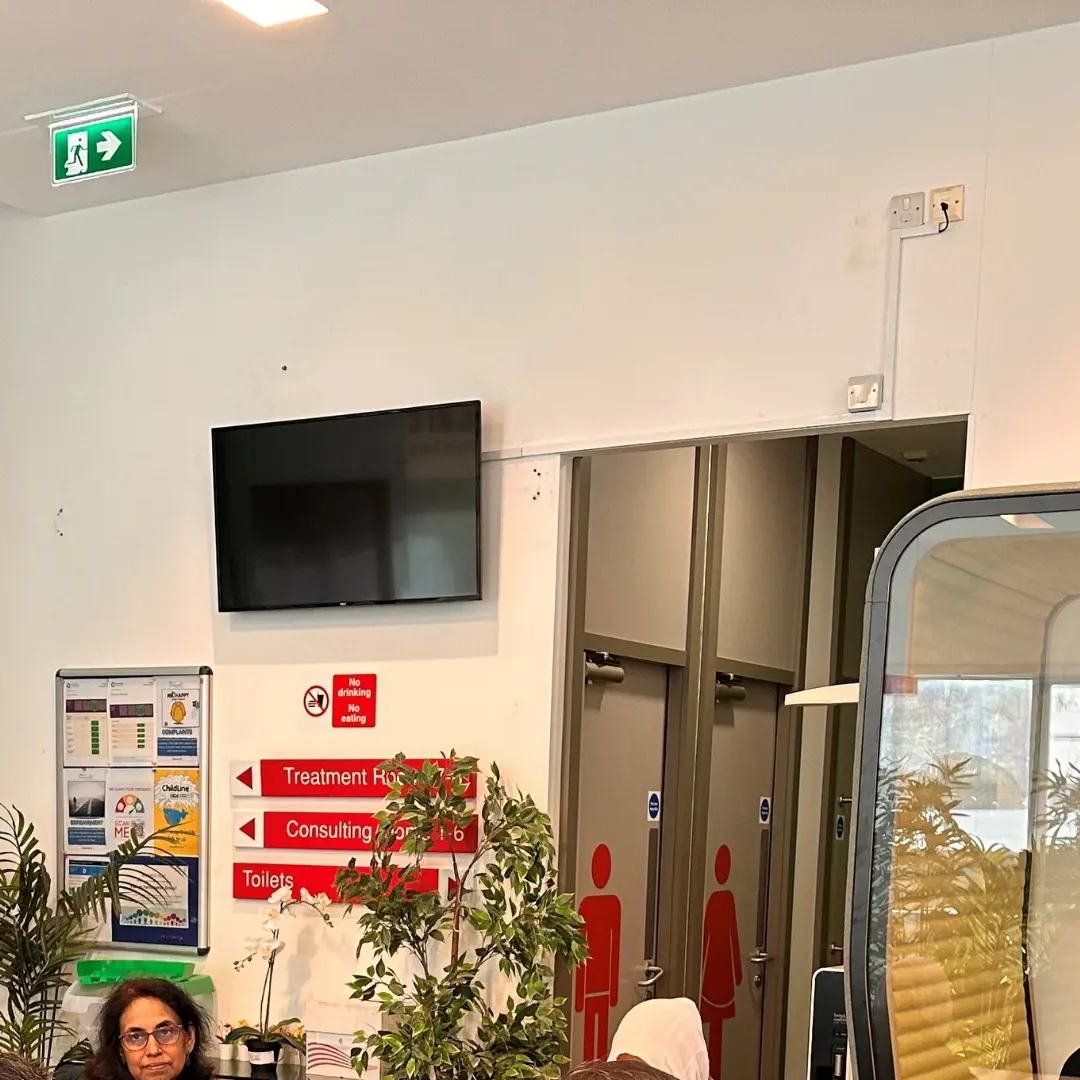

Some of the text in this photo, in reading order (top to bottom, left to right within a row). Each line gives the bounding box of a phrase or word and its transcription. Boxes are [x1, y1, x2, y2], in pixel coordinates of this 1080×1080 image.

[348, 677, 361, 687] No
[337, 687, 372, 698] drinking
[348, 703, 360, 713] No
[341, 713, 367, 724] eating
[282, 766, 368, 786] Treatment
[114, 826, 130, 838] ME
[286, 820, 372, 844] Consulting
[242, 869, 294, 889] Toilets
